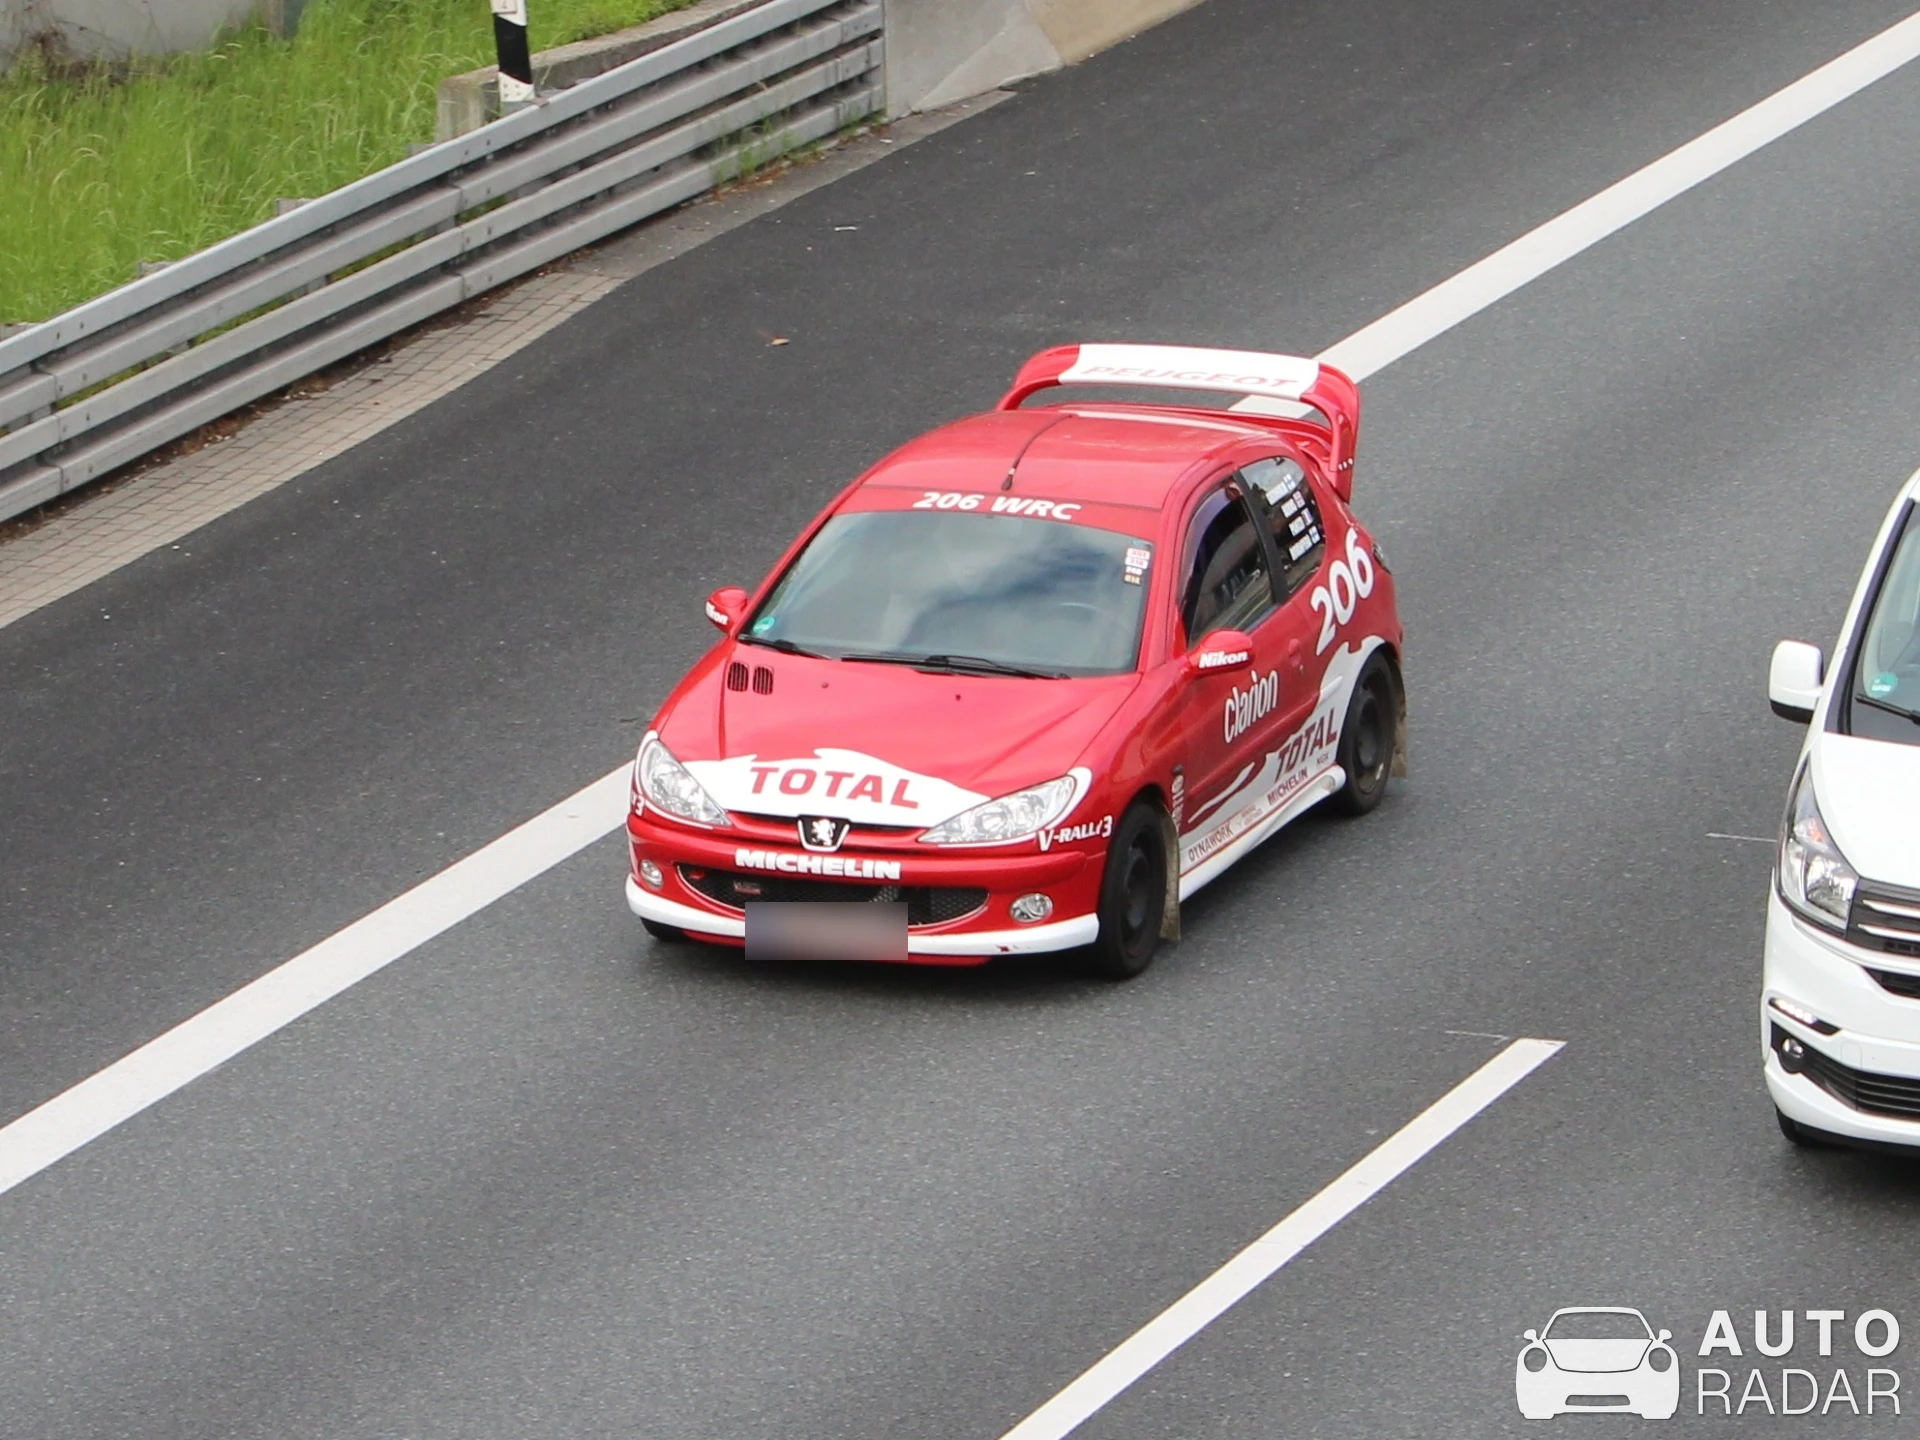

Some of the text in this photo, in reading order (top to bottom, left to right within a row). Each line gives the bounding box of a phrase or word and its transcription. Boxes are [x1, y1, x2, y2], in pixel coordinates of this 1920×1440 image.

[1081, 366, 1298, 387] PEUGEOT
[912, 492, 1082, 520] 206 WRC
[1310, 527, 1374, 656] 206
[1199, 651, 1248, 668] Nikon
[1225, 670, 1278, 743] clarion
[1275, 707, 1337, 784] TOTAL
[750, 767, 919, 809] TOTAL
[1267, 766, 1308, 805] MICHELIN
[735, 849, 901, 880] MICHELIN
